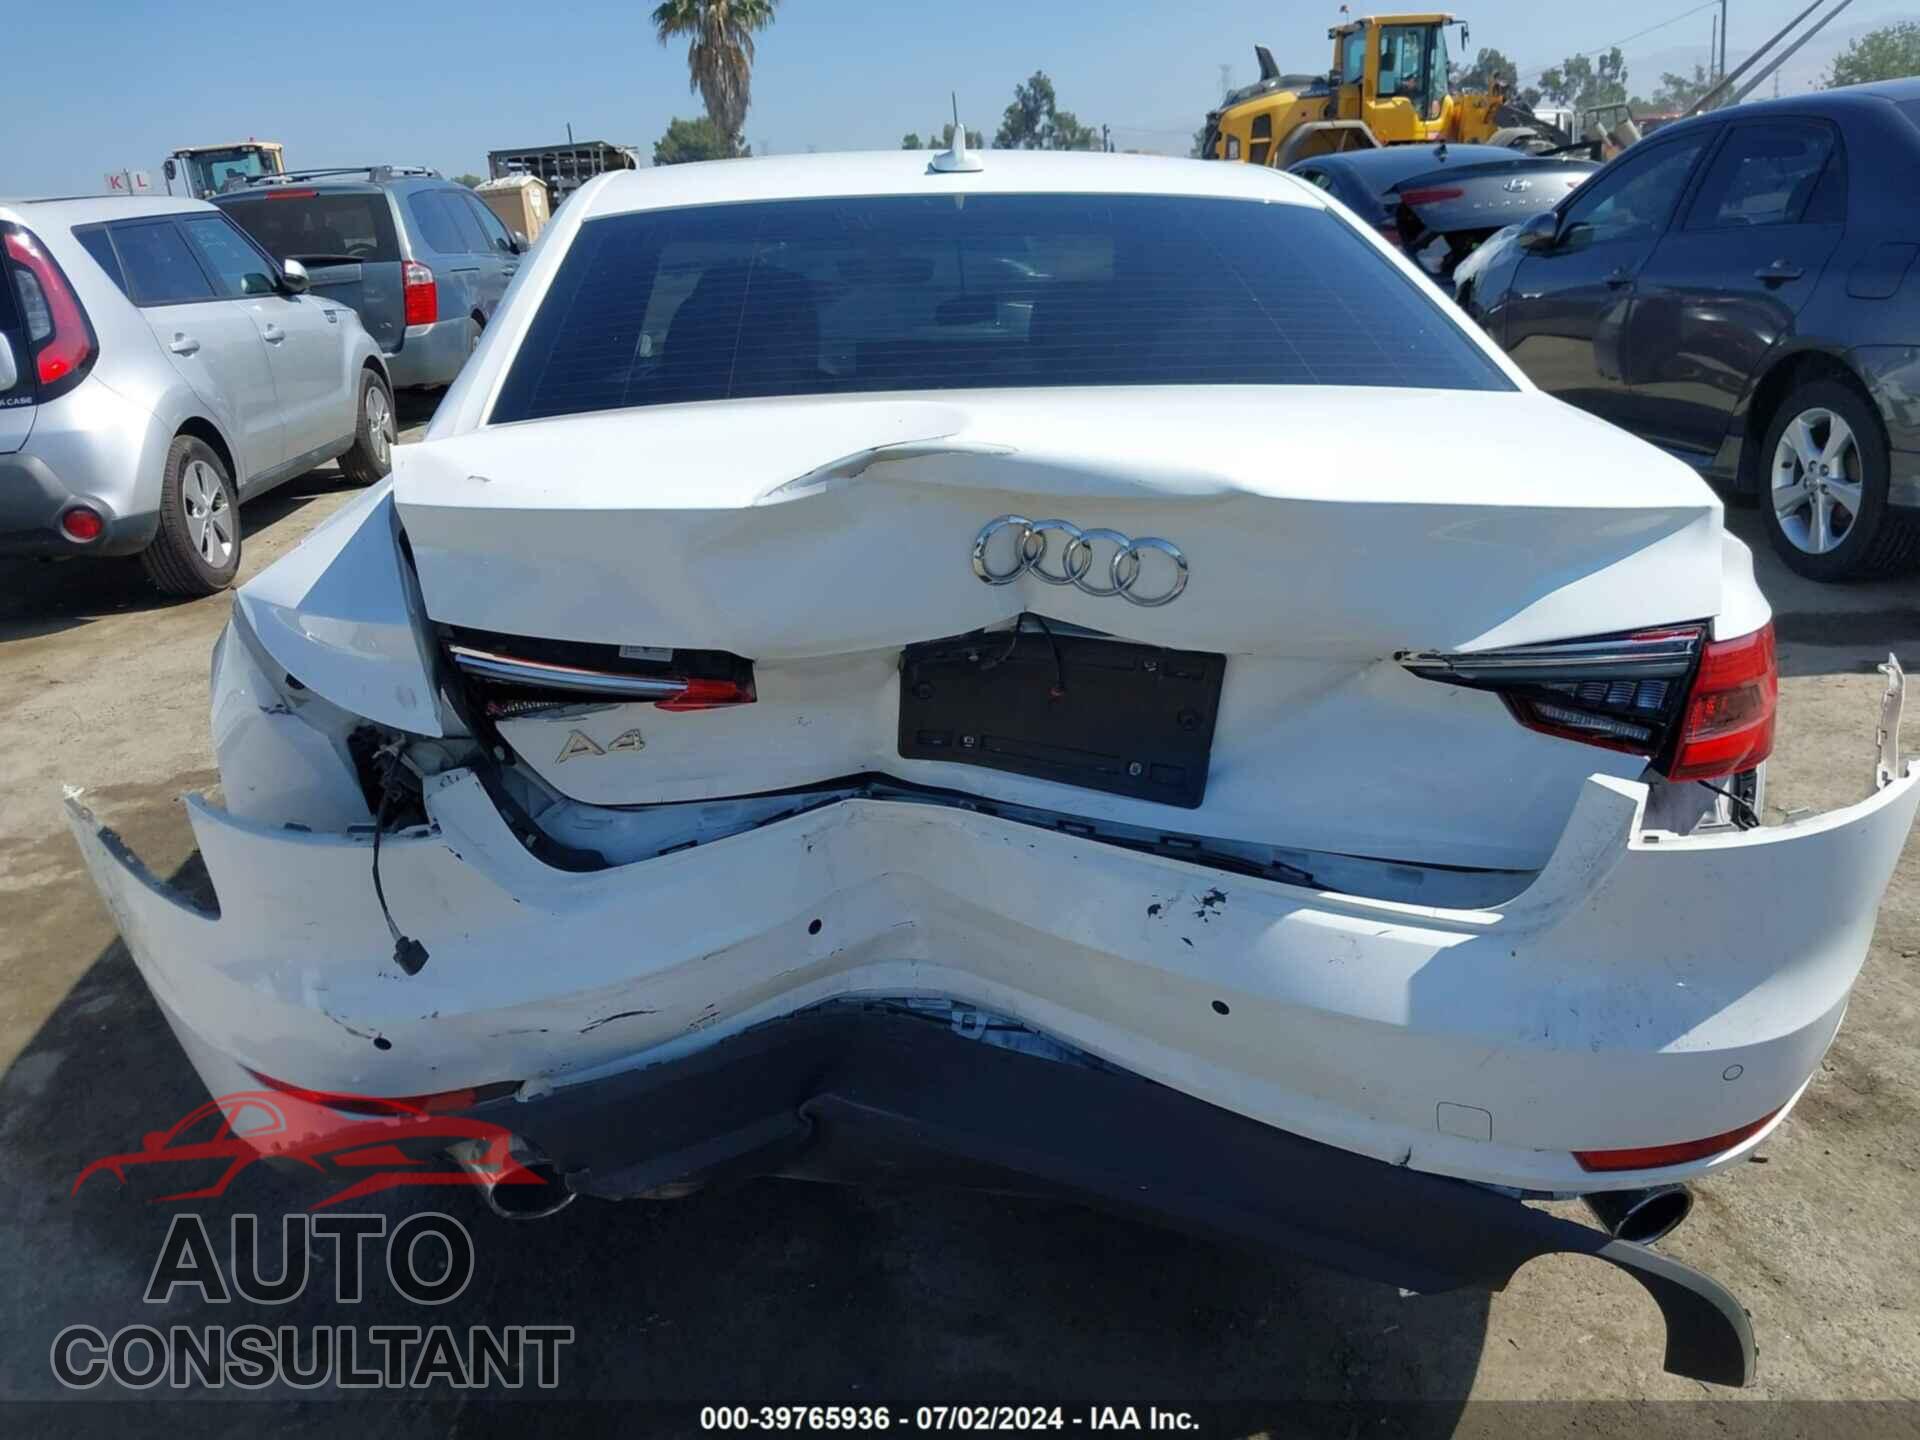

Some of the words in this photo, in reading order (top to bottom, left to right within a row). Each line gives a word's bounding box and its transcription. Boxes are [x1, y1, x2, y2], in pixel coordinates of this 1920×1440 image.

[110, 176, 122, 189] K
[136, 174, 148, 187] L
[554, 728, 646, 764] A4
